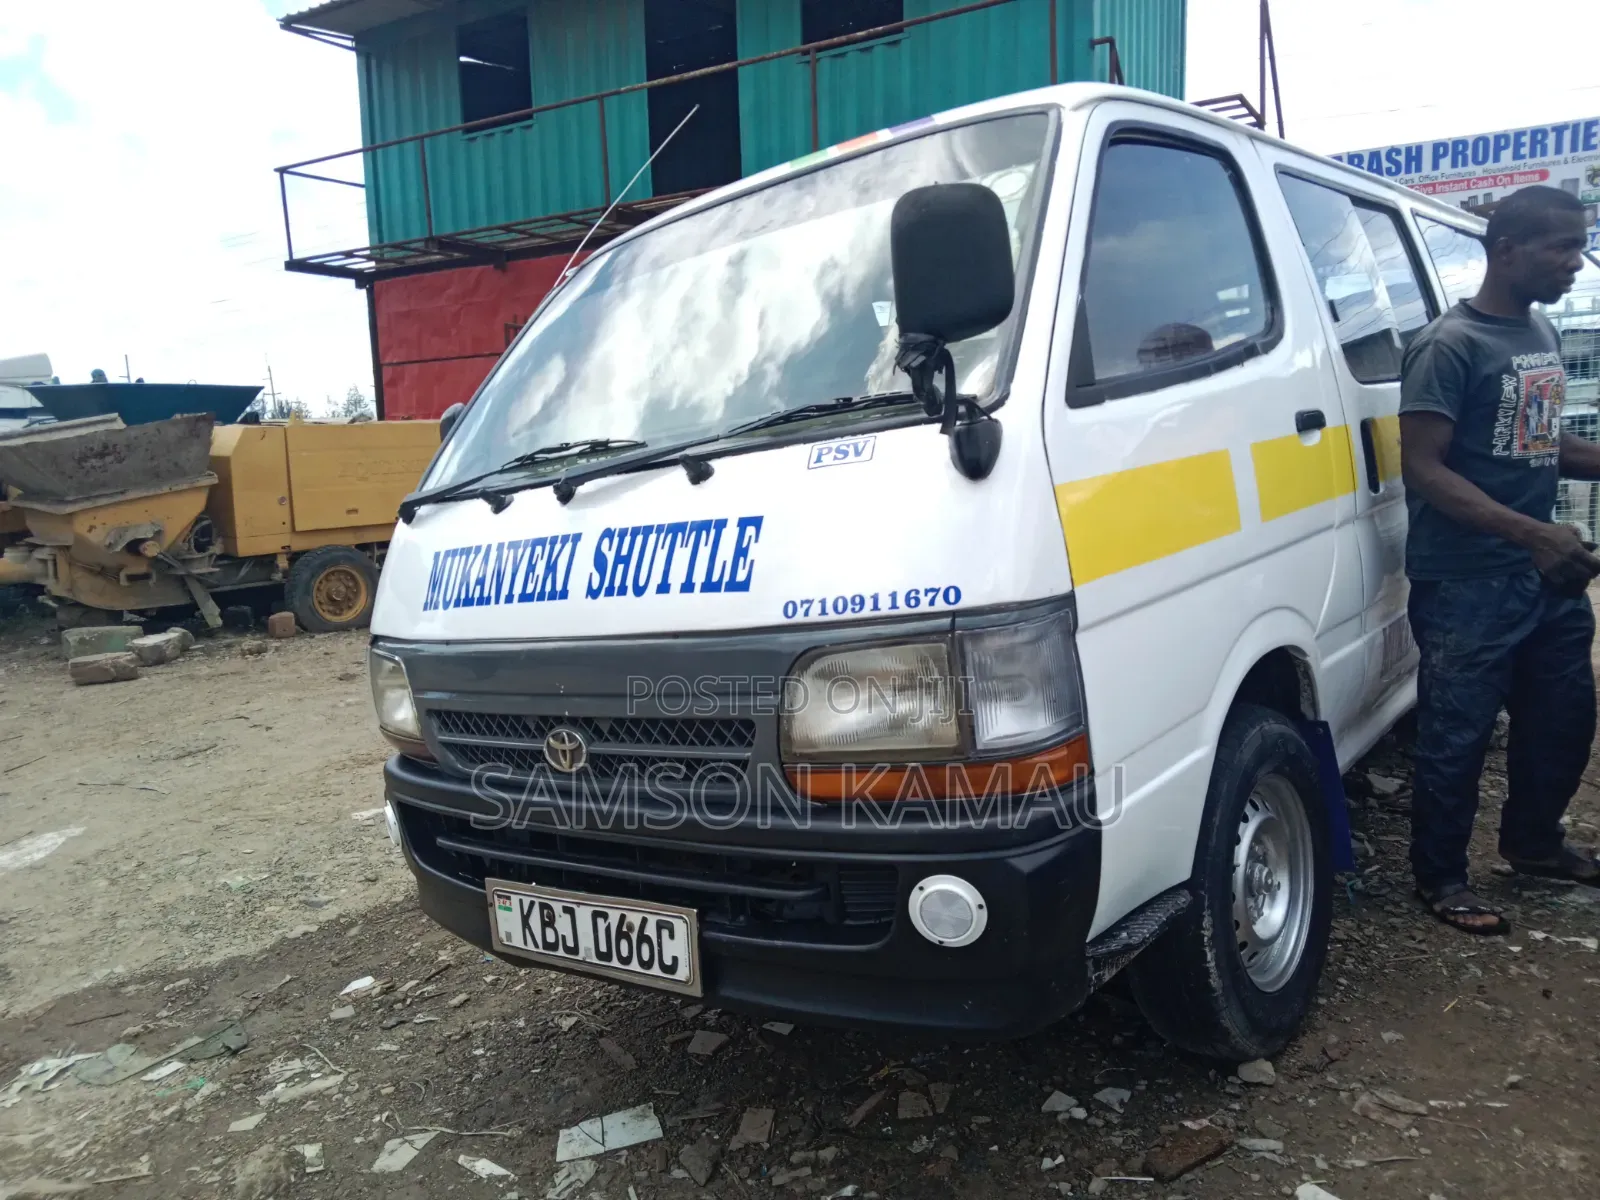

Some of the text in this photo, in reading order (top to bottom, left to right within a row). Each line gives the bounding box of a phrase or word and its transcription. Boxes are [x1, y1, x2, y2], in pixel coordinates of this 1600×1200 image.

[1432, 119, 1600, 171] PROPERTIE
[1435, 181, 1468, 193] Instant
[1470, 177, 1494, 188] Cash
[1496, 175, 1511, 185] On
[1513, 173, 1540, 183] Items
[1492, 374, 1517, 456] PARKVIEW
[813, 440, 870, 464] PSV
[422, 515, 764, 612] MUKANYEKI SHUTTLE
[783, 585, 962, 619] 0710911670
[518, 898, 580, 956] KBJ
[591, 909, 679, 975] 066C
